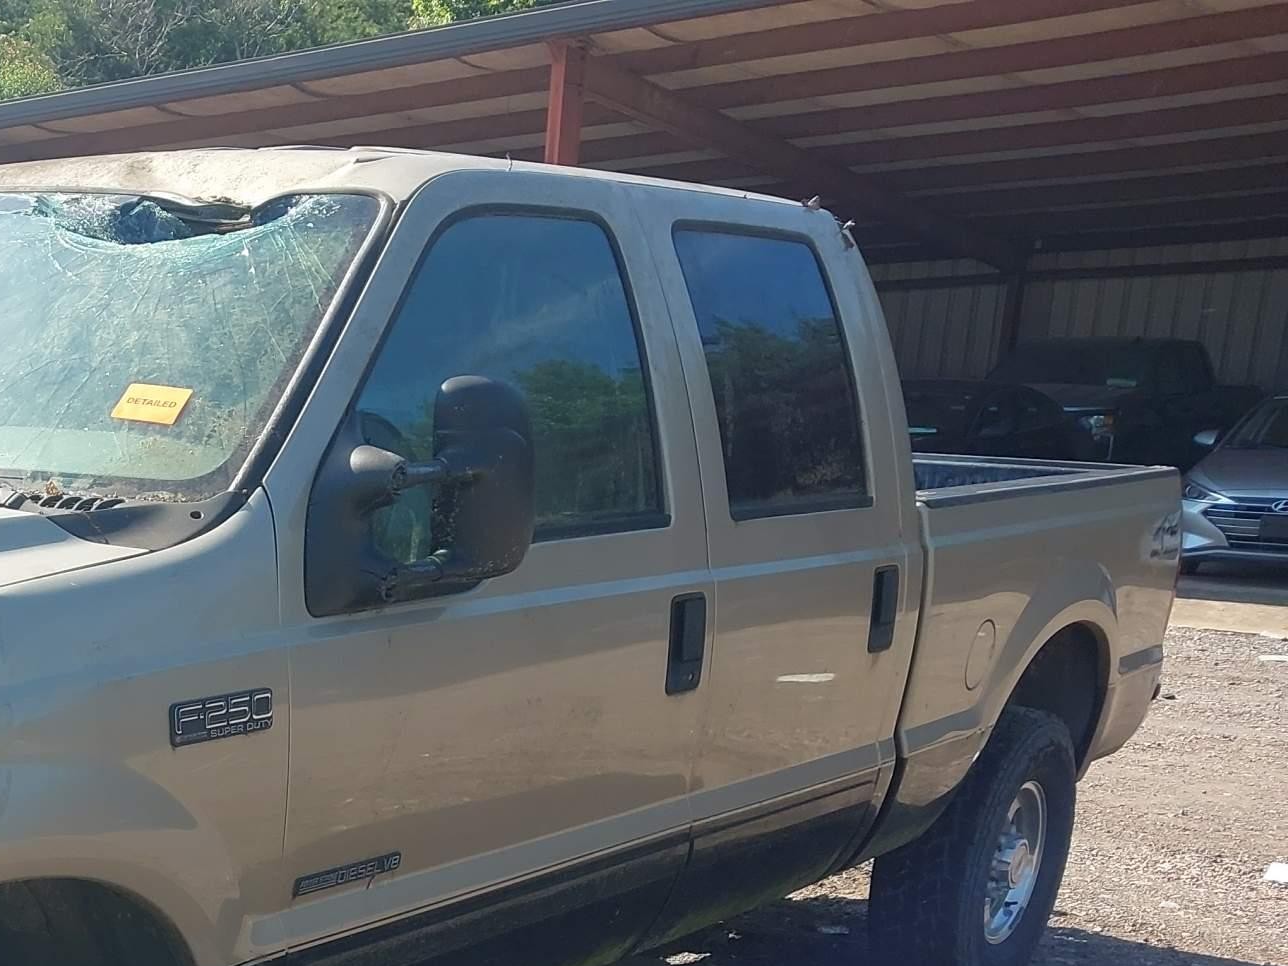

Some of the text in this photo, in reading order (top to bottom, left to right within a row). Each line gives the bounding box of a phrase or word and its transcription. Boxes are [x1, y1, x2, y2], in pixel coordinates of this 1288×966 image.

[127, 397, 177, 408] DETAILED
[210, 718, 273, 738] SUPER DUTY
[338, 855, 400, 884] DIESEL V8
